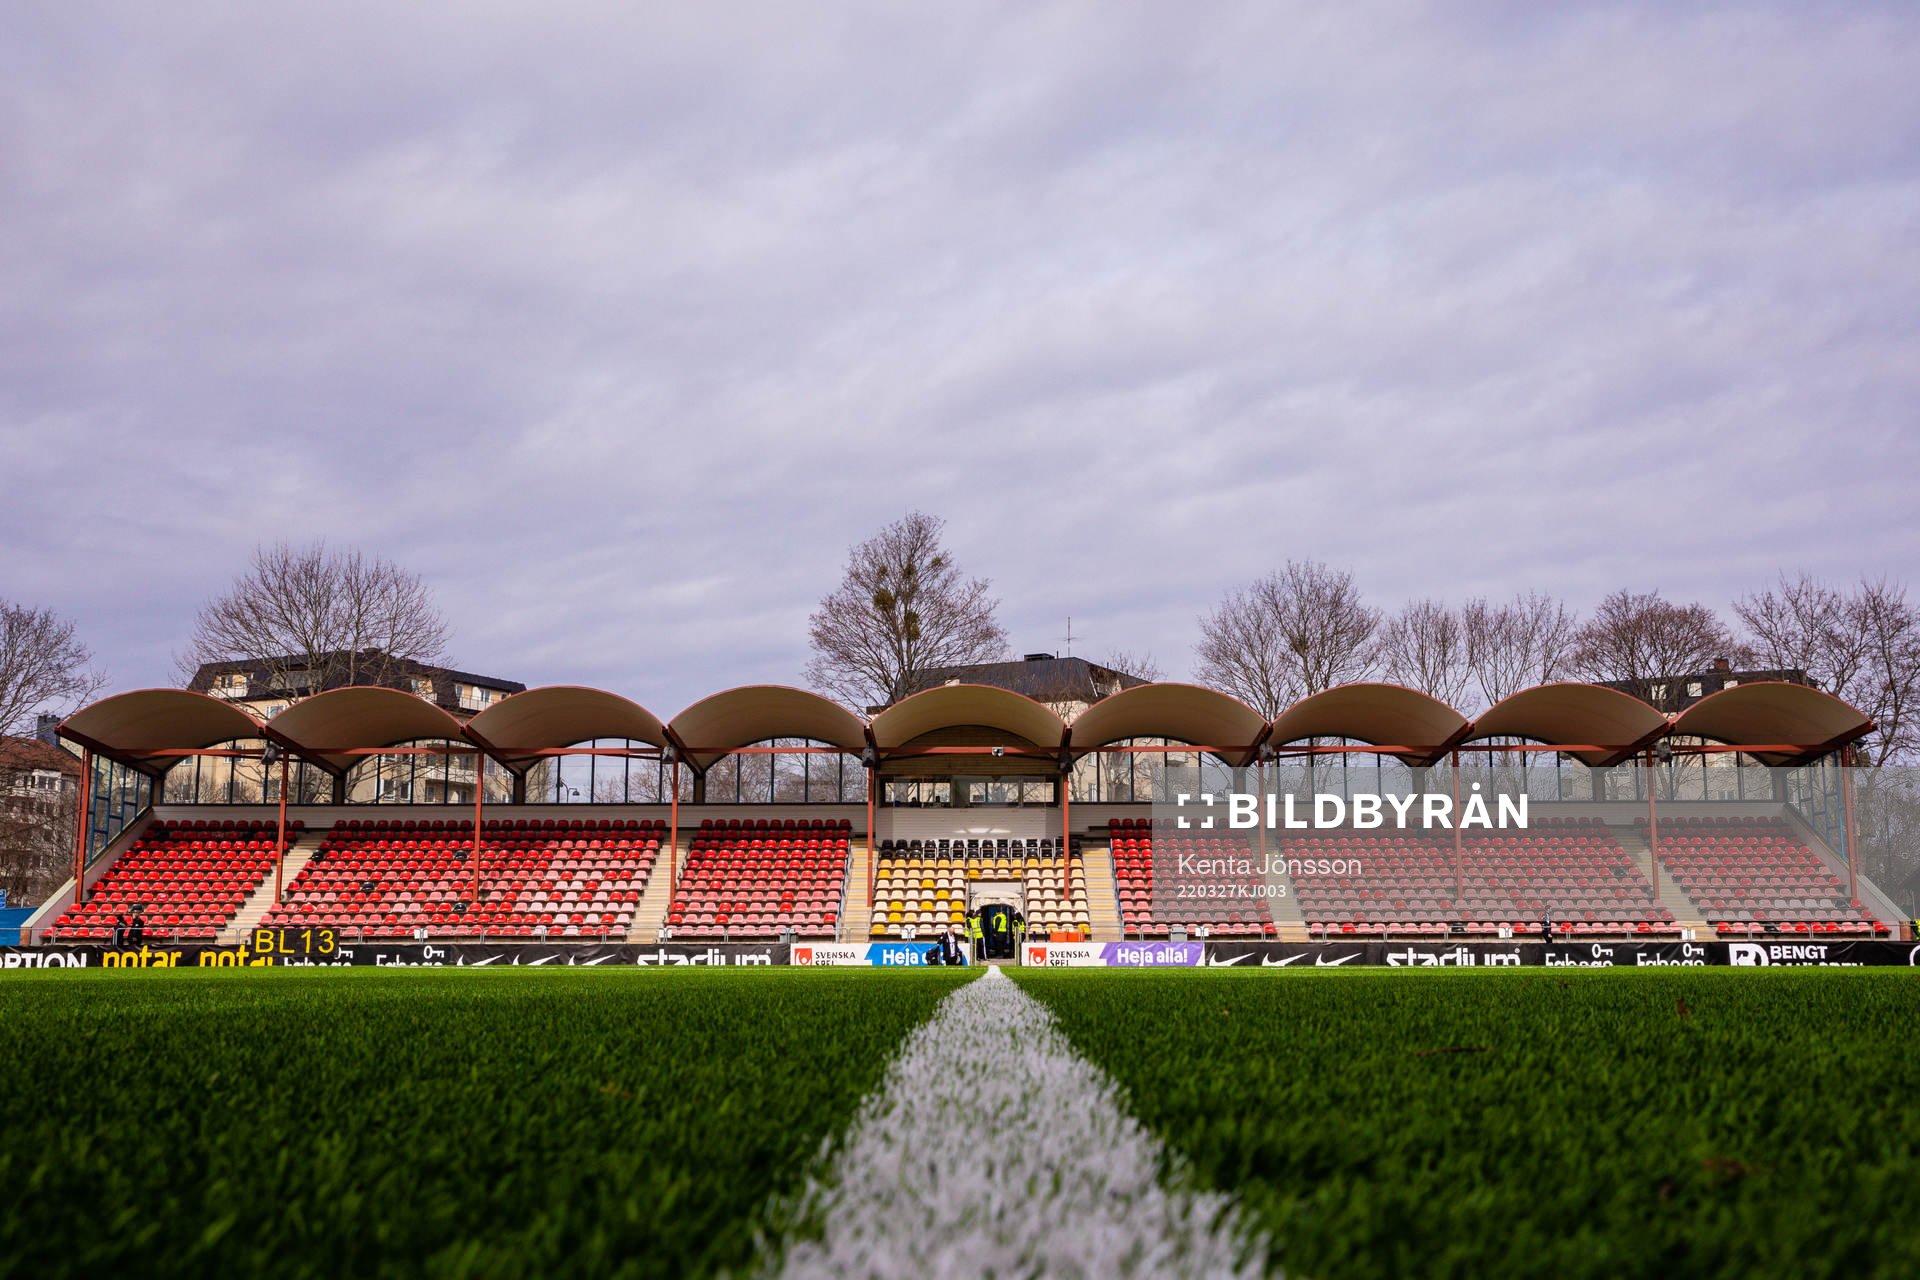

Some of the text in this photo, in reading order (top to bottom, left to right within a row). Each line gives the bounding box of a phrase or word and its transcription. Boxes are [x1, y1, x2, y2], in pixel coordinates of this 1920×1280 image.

[0, 952, 87, 968] PTION
[103, 944, 182, 968] notar
[815, 951, 856, 959] SVENSKA
[882, 948, 919, 966] Heja
[1049, 951, 1090, 959] SVENSKA
[1116, 947, 1188, 967] Heja alla!
[1769, 945, 1829, 959] BENGT
